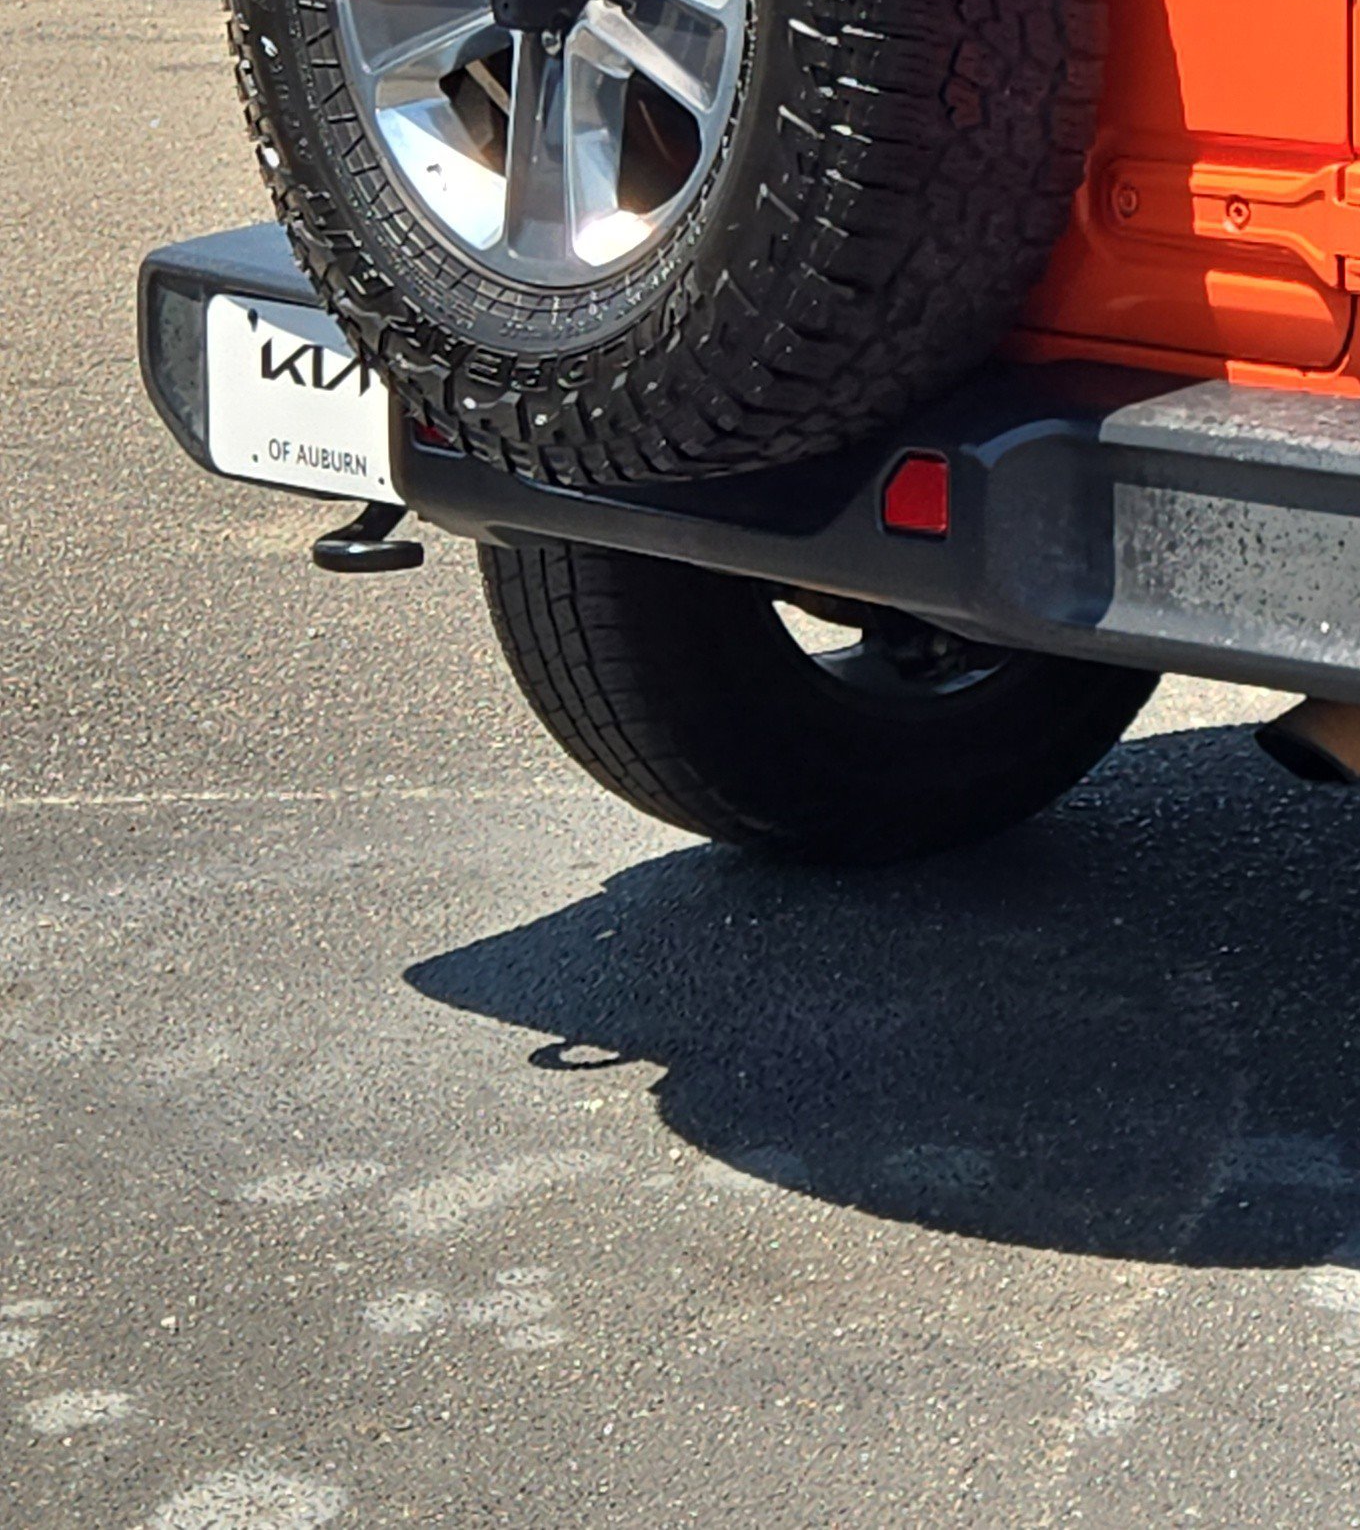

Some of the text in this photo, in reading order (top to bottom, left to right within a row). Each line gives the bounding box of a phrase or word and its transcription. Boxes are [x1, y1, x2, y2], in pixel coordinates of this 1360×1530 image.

[261, 338, 370, 396] KIA
[268, 438, 367, 477] OF AUBURN
